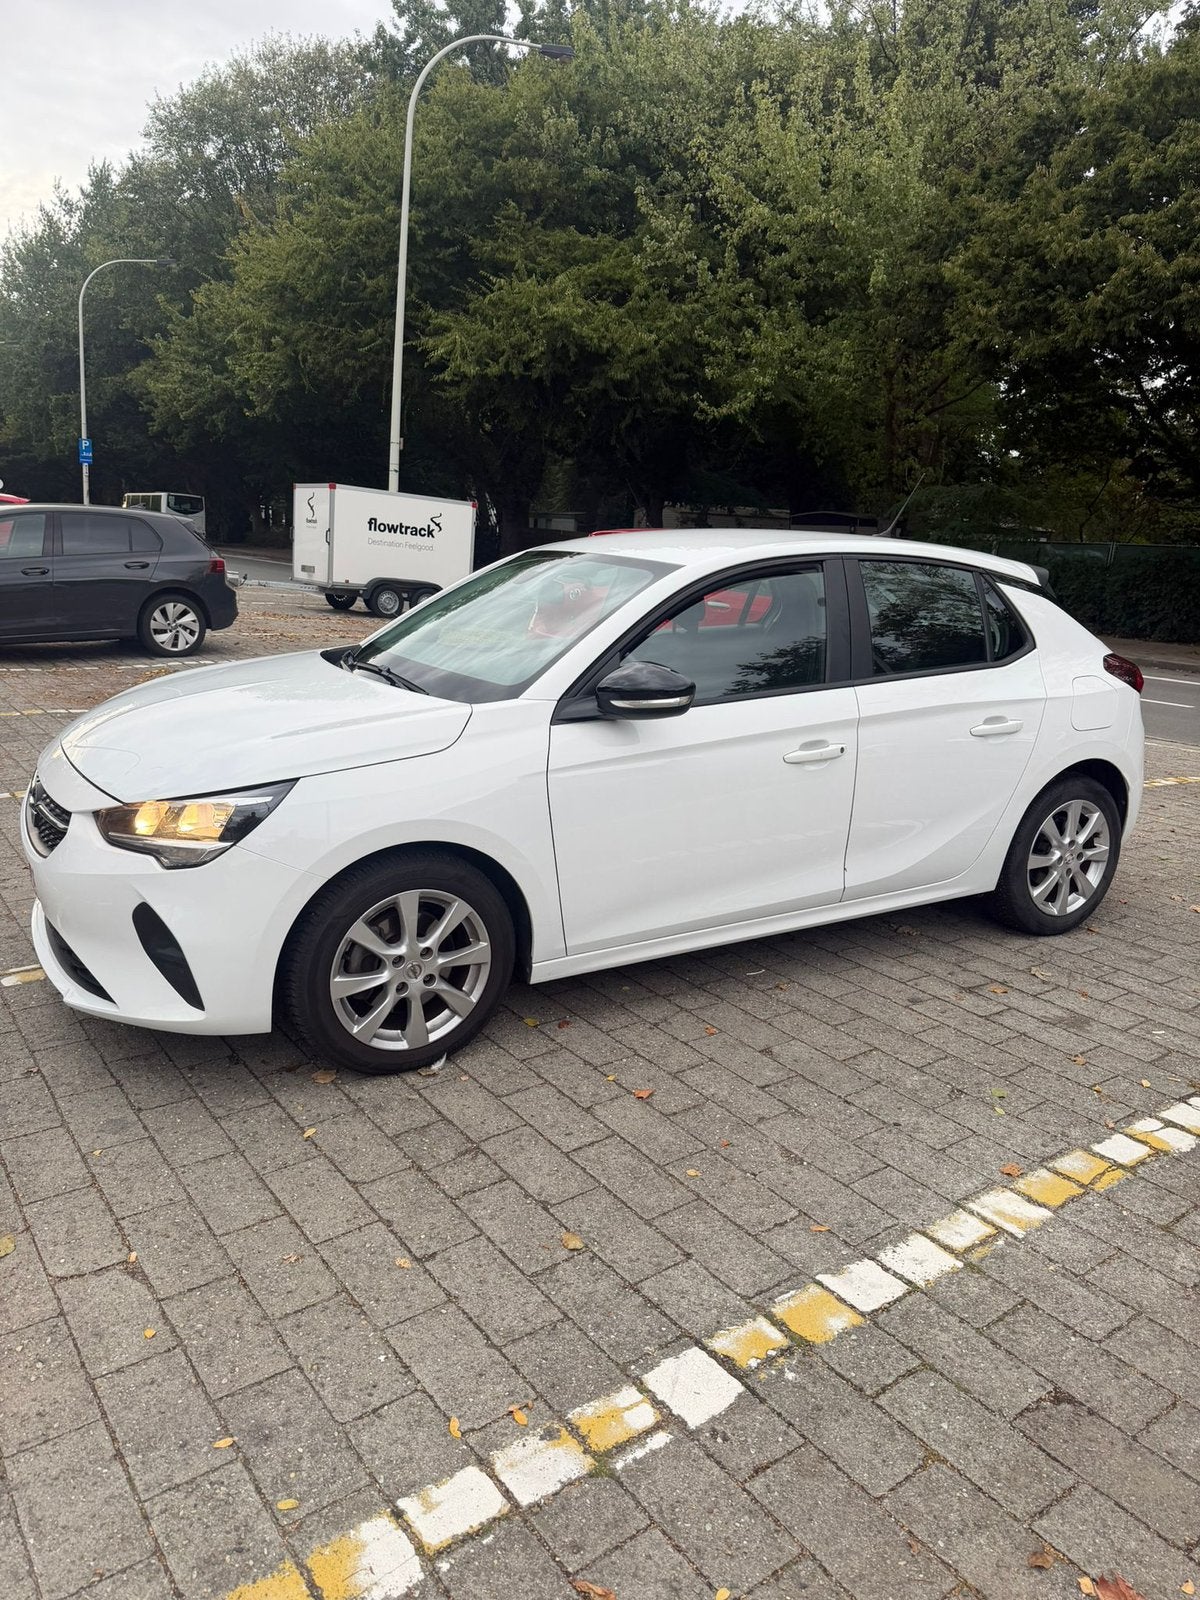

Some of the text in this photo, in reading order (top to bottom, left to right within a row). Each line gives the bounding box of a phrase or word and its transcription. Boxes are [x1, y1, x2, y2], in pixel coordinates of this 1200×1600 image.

[82, 440, 89, 450] P
[367, 517, 435, 538] flowtrack
[368, 538, 434, 552] Destination Feelgood
